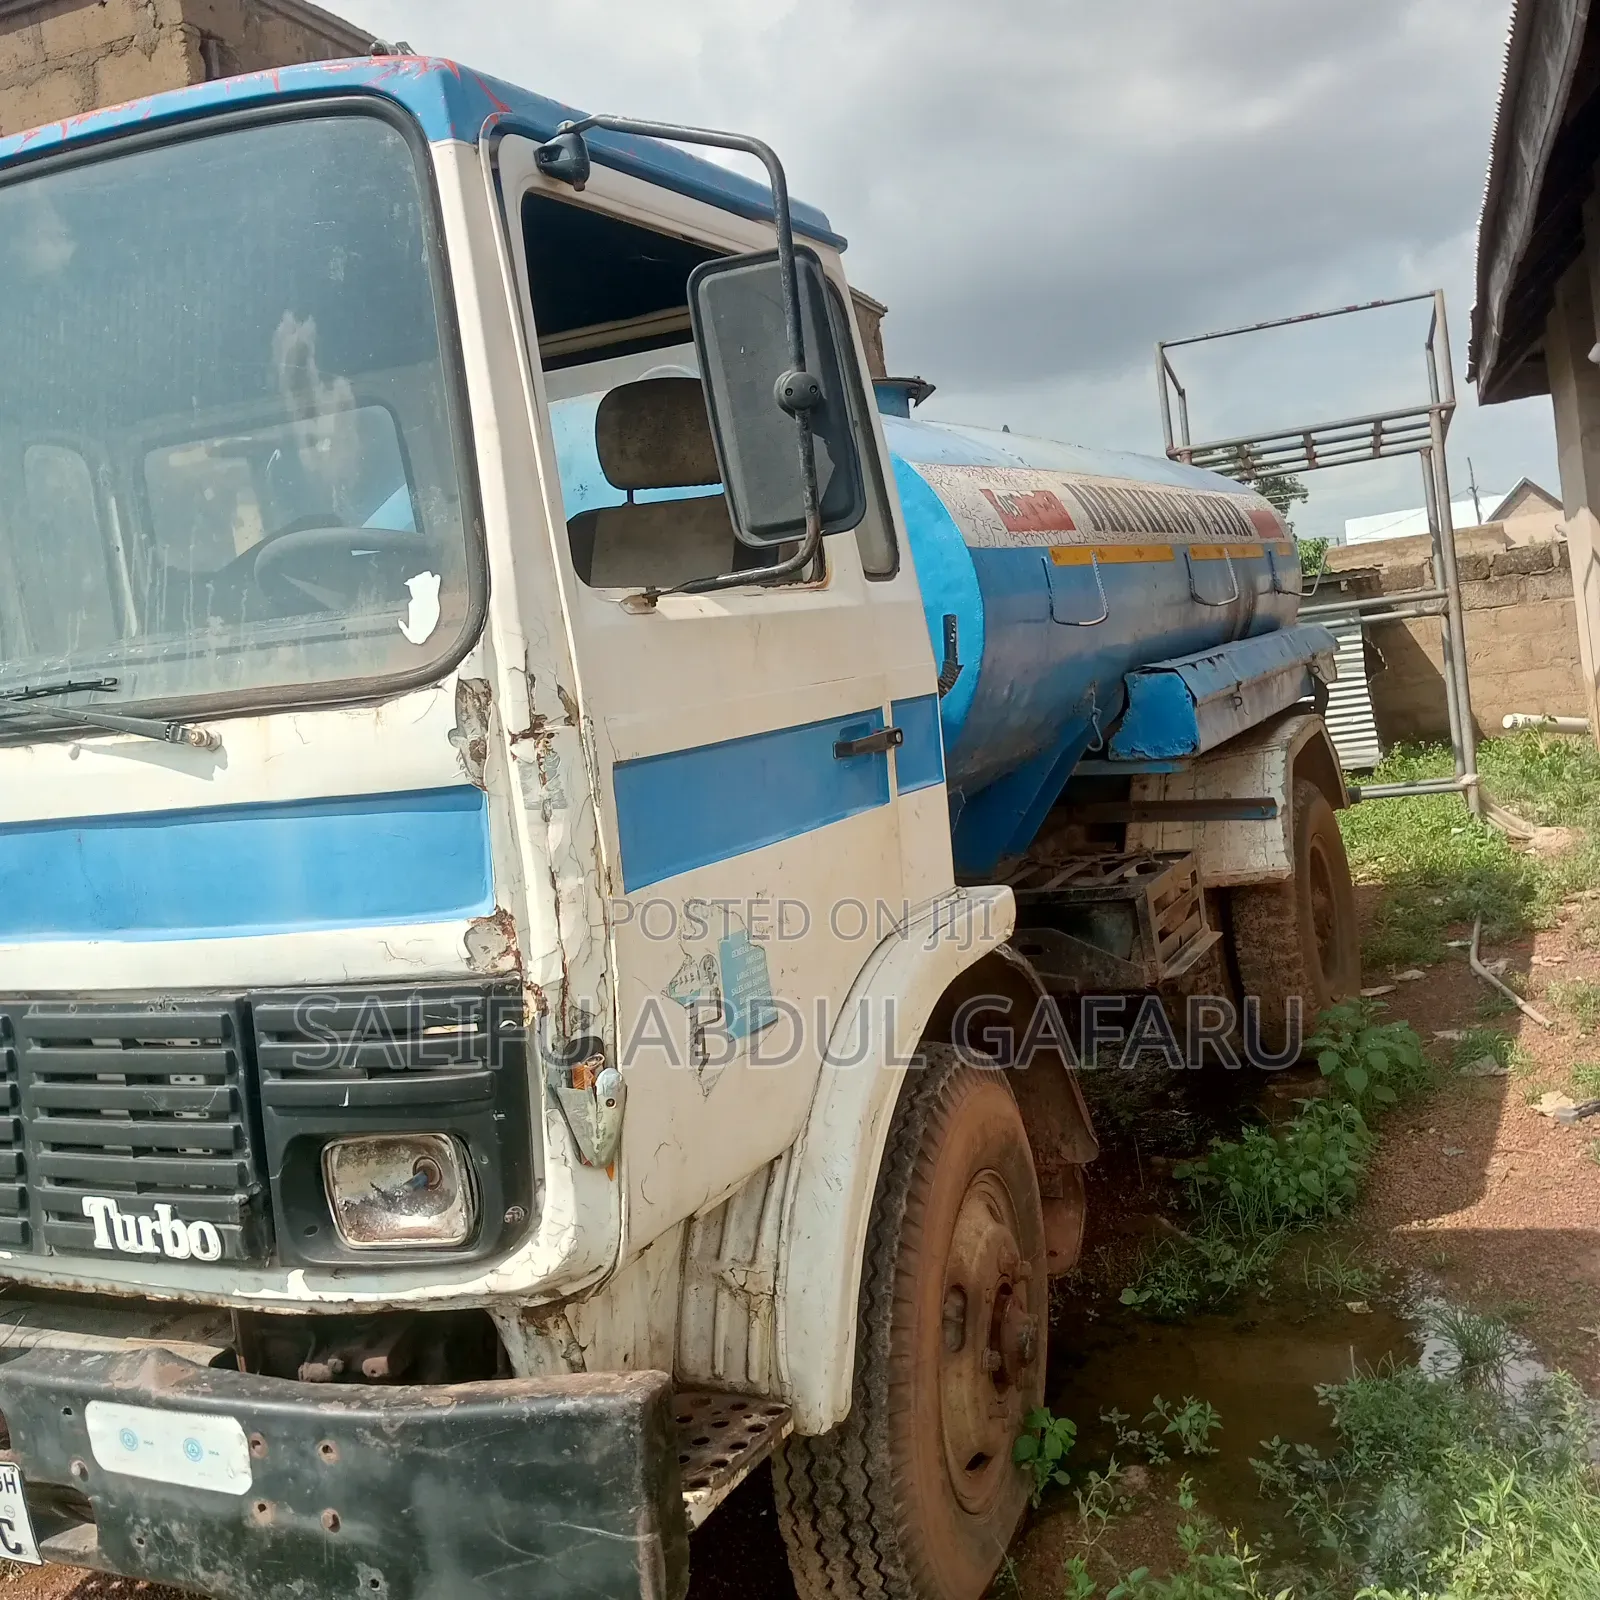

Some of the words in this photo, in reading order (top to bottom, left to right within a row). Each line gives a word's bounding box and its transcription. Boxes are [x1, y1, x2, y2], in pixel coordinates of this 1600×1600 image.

[1061, 482, 1196, 534] DRINKING
[1176, 493, 1253, 537] WATER
[81, 1195, 222, 1261] Turbo
